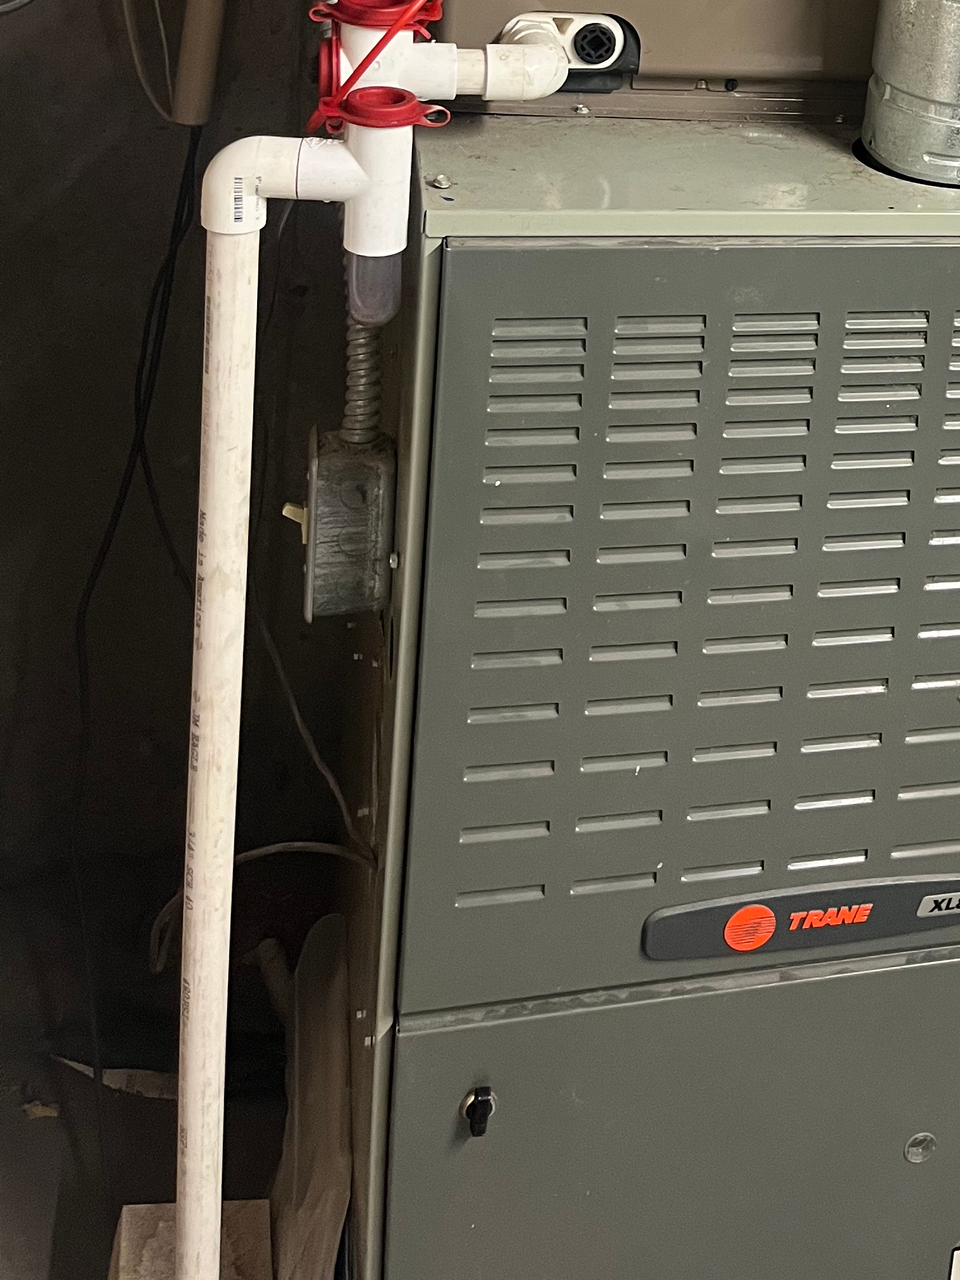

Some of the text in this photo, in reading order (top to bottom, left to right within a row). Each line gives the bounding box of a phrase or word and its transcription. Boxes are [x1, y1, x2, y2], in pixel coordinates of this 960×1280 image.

[198, 510, 207, 542] Made
[197, 551, 205, 567] in
[195, 572, 205, 629] America
[788, 903, 873, 931] TRANE
